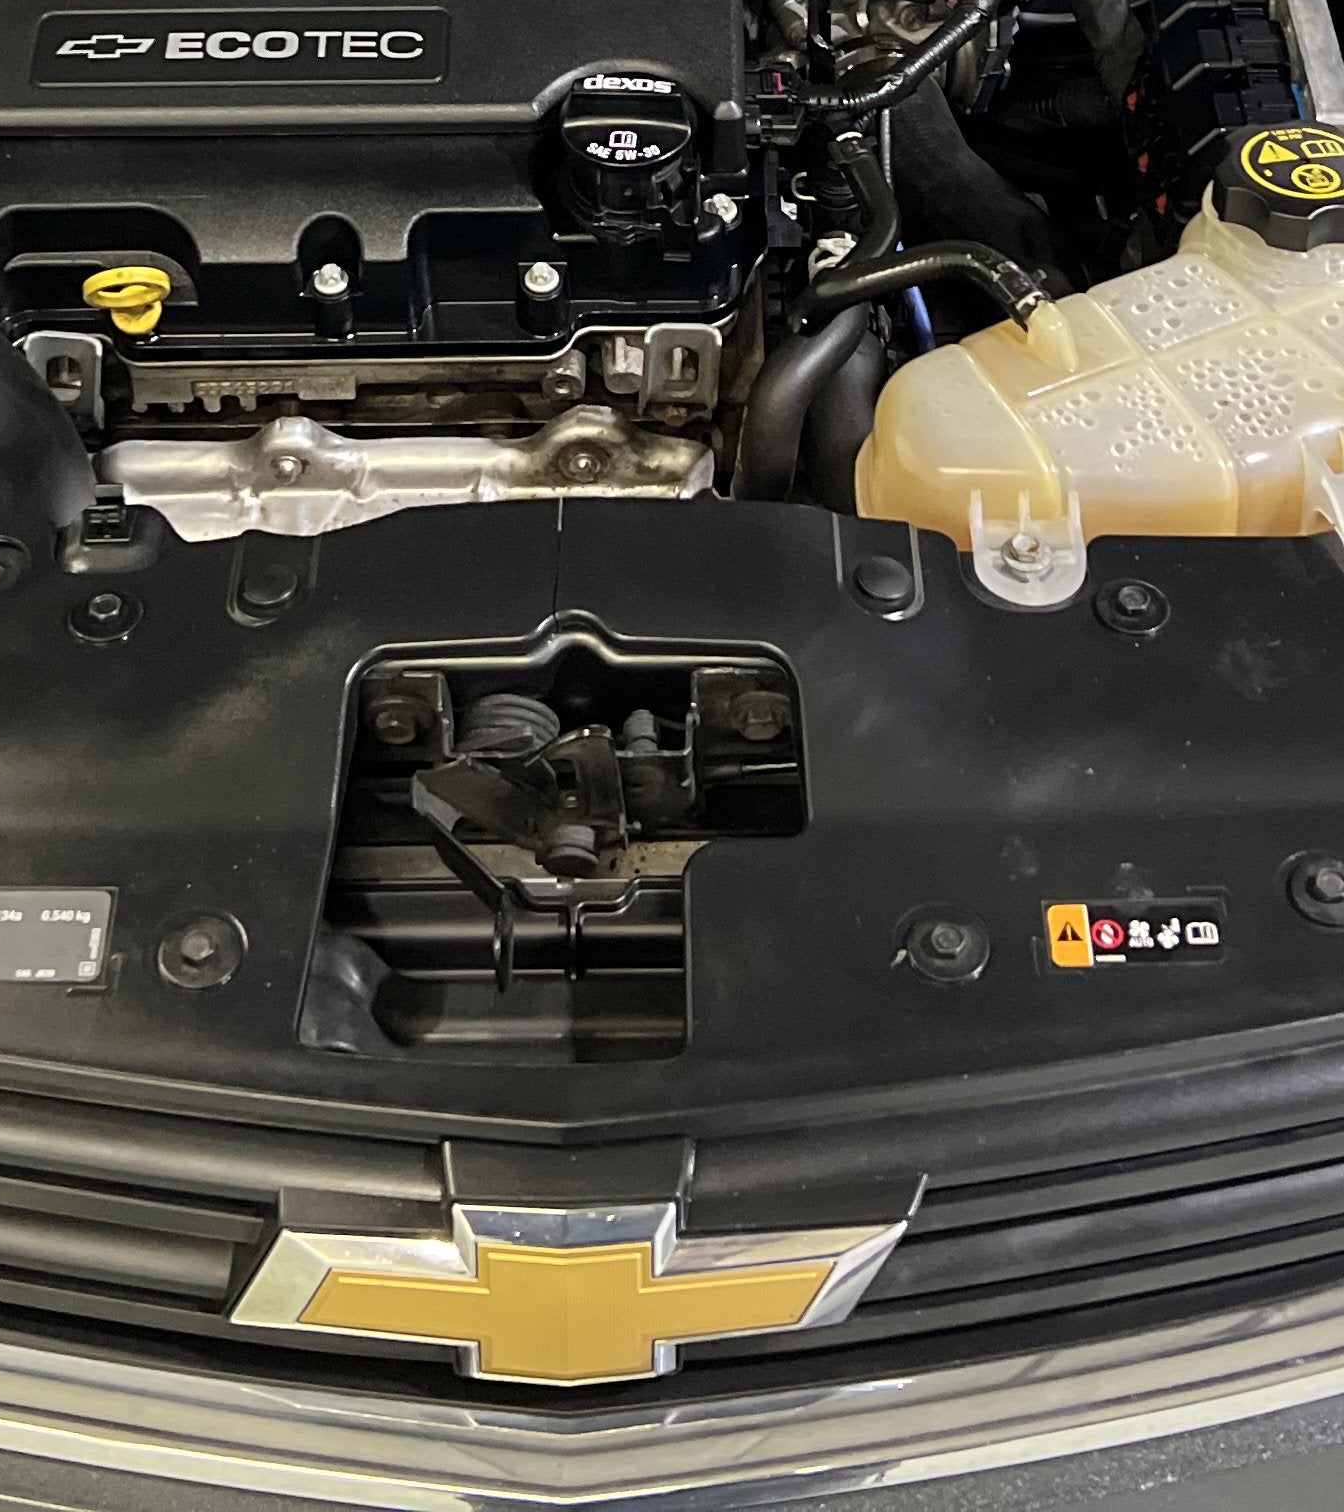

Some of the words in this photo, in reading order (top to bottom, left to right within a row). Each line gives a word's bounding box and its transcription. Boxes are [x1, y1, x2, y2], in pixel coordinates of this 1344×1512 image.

[164, 30, 424, 60] ECOTEC
[583, 74, 673, 94] dexos
[586, 142, 612, 159] SAE
[614, 144, 661, 161] 5W-30
[75, 909, 91, 924] kg
